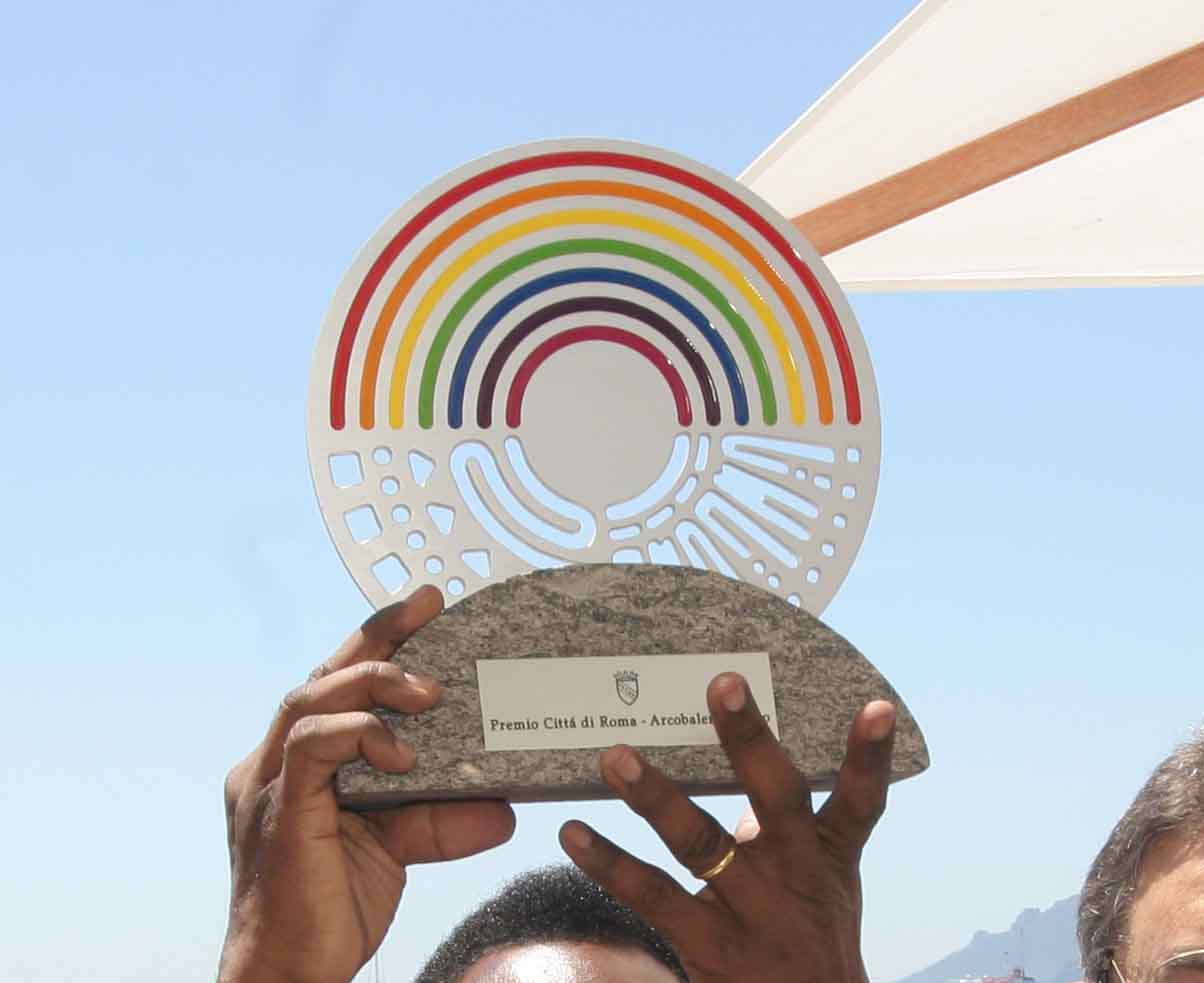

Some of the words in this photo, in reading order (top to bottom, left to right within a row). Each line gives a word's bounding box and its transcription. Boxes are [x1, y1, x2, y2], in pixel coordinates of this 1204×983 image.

[490, 718, 539, 731] Premio
[581, 715, 595, 728] di
[599, 714, 638, 728] Roma
